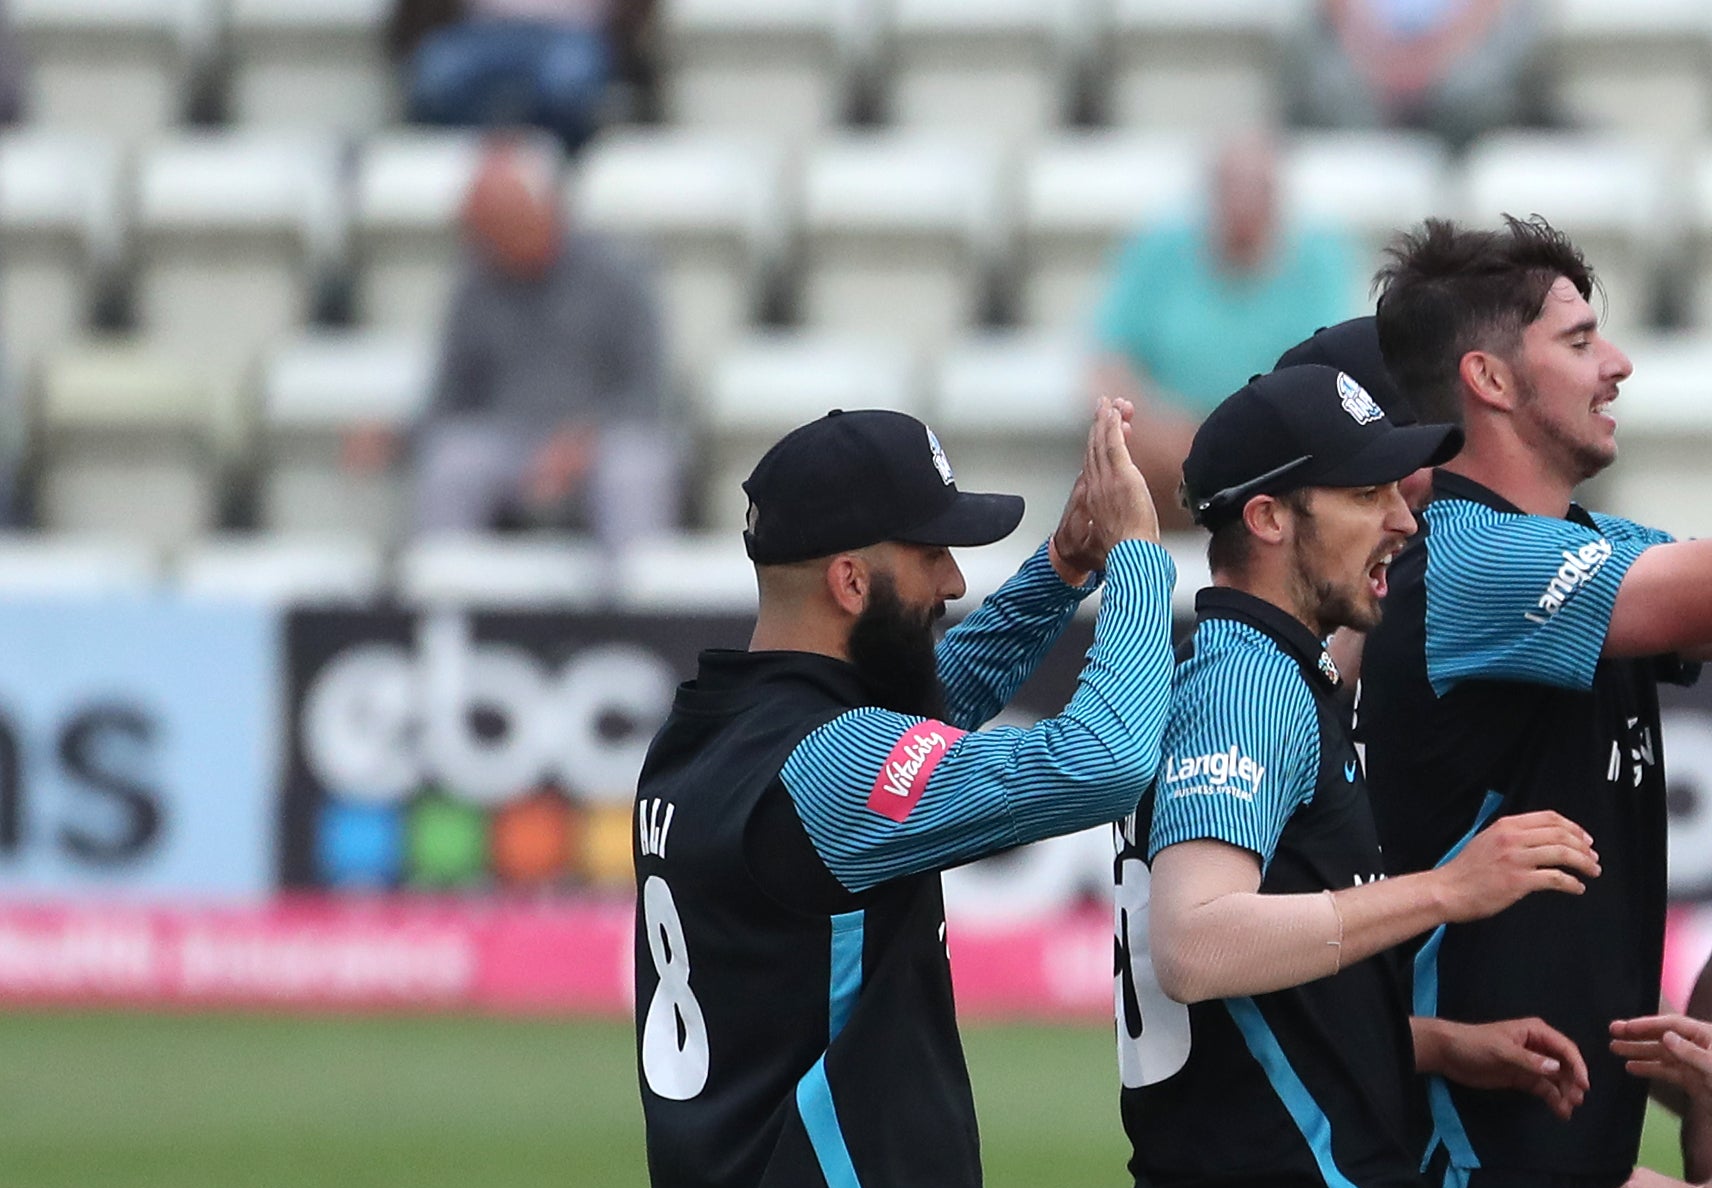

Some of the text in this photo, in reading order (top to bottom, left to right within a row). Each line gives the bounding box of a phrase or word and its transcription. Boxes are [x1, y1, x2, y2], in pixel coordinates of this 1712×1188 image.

[883, 732, 946, 797] Vitality
[1166, 745, 1265, 793] Langley
[640, 798, 675, 859] ALI
[643, 875, 710, 1101] 8
